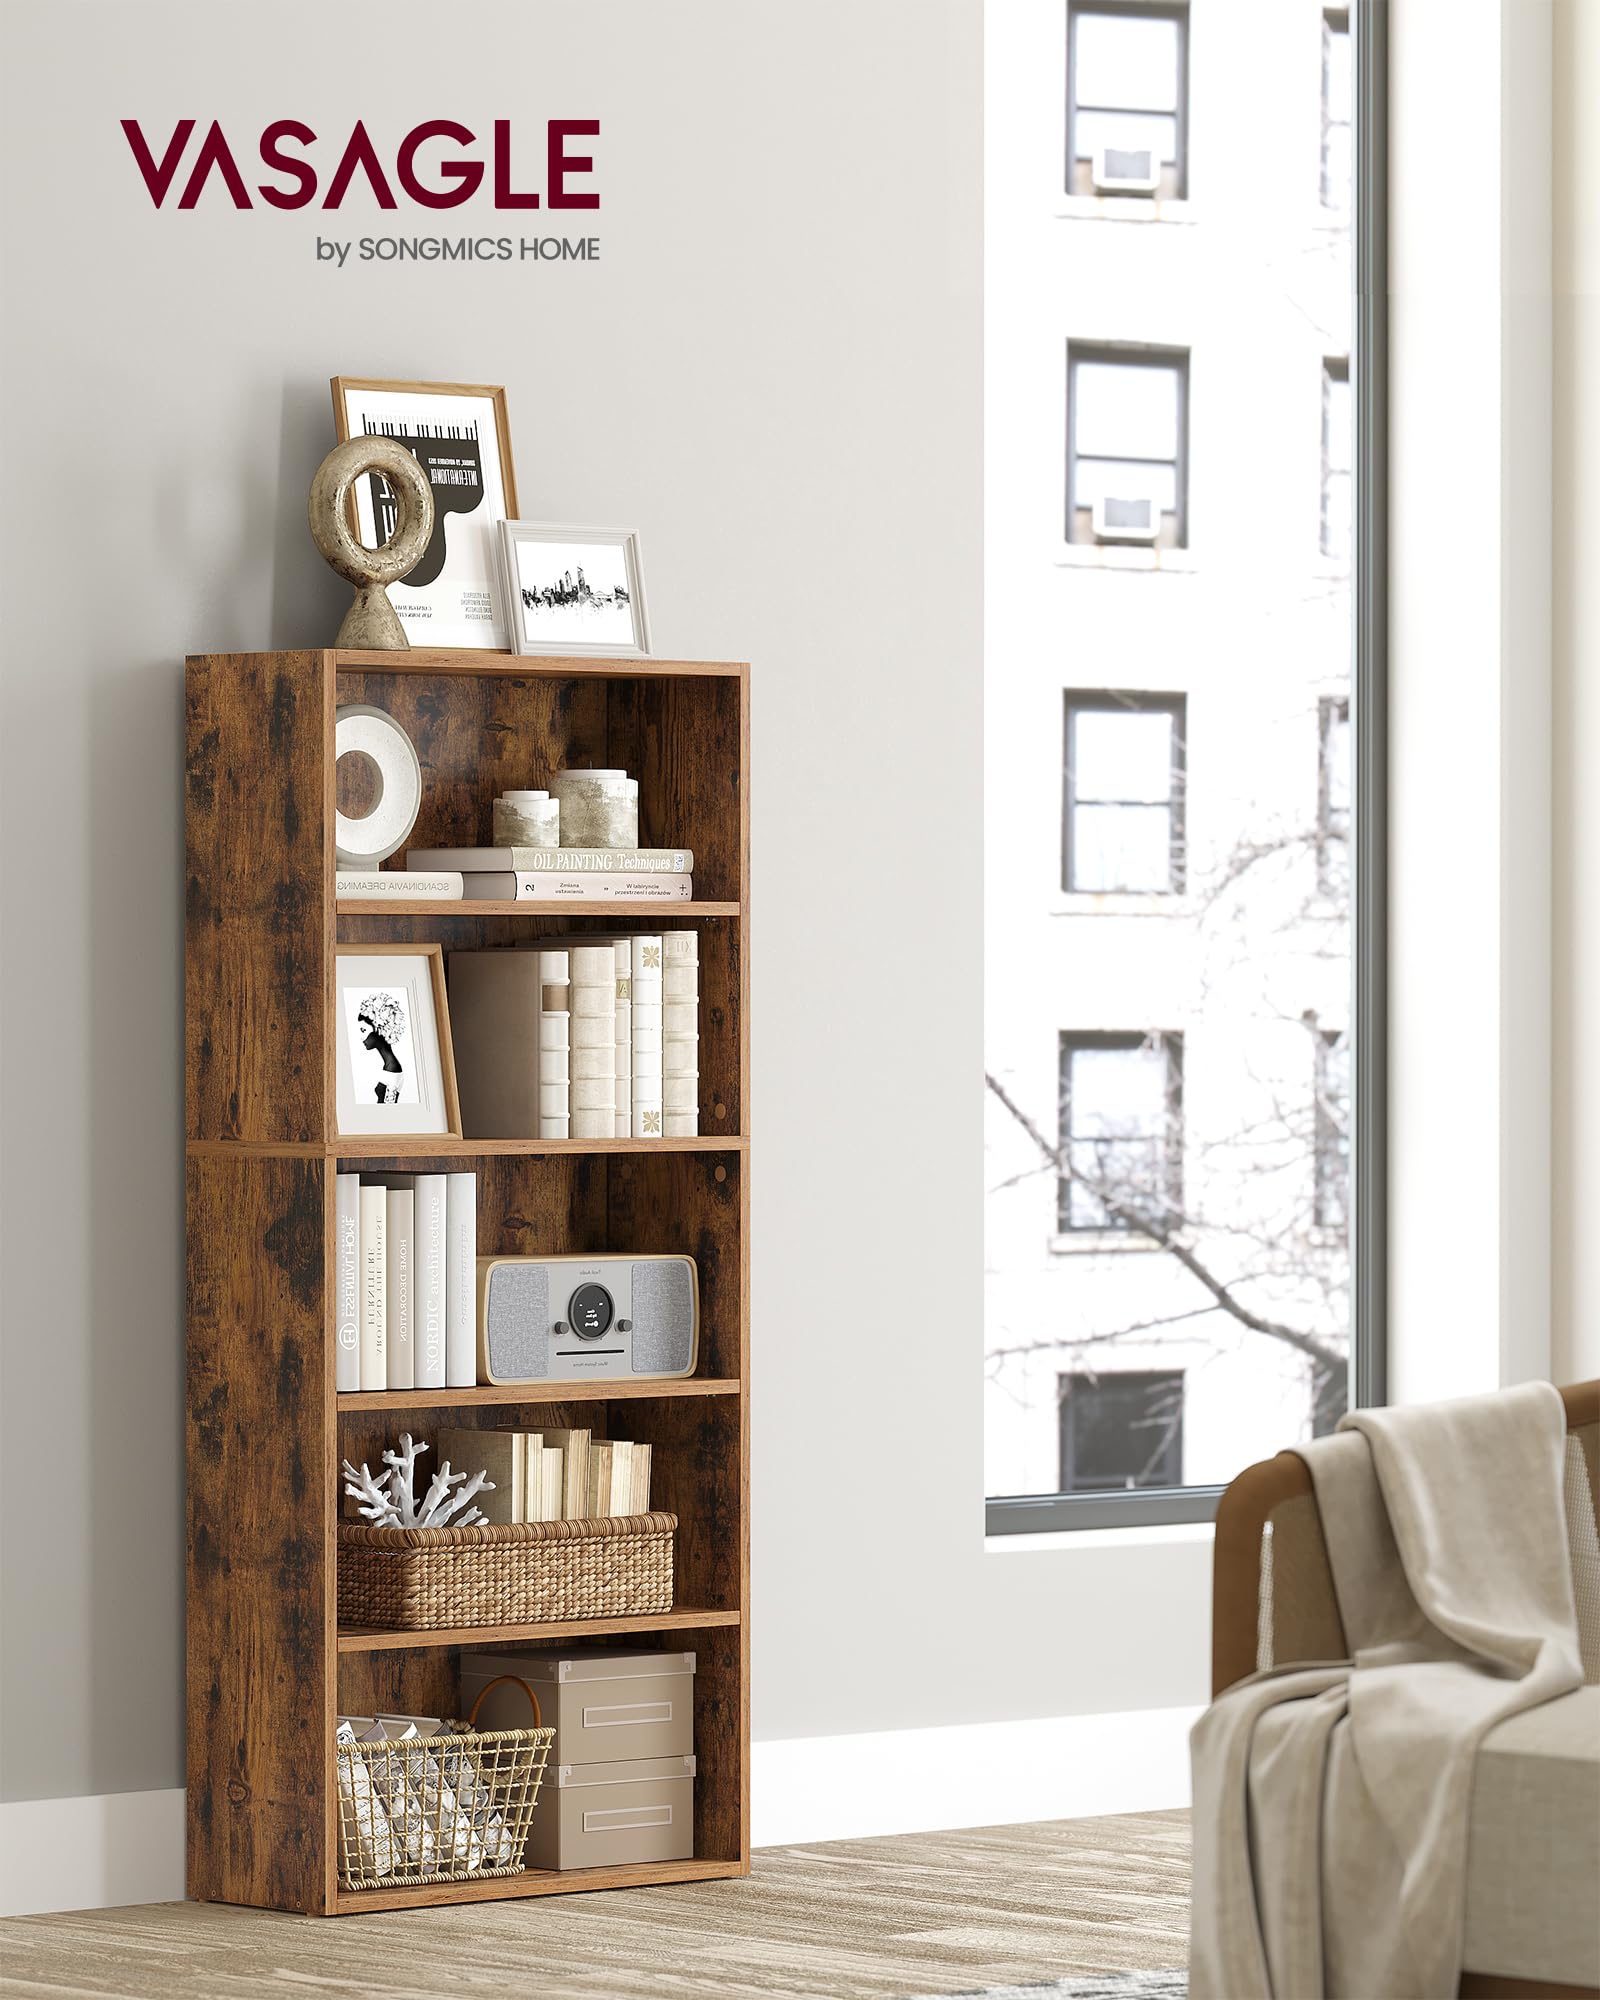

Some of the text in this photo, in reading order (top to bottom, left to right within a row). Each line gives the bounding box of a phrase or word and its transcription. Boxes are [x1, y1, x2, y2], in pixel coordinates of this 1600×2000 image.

[534, 853, 554, 870] OIL
[556, 853, 613, 870] PAINTING
[616, 853, 671, 873] Techniques
[525, 884, 535, 892] 2
[427, 1196, 440, 1372] NORDIC architecture
